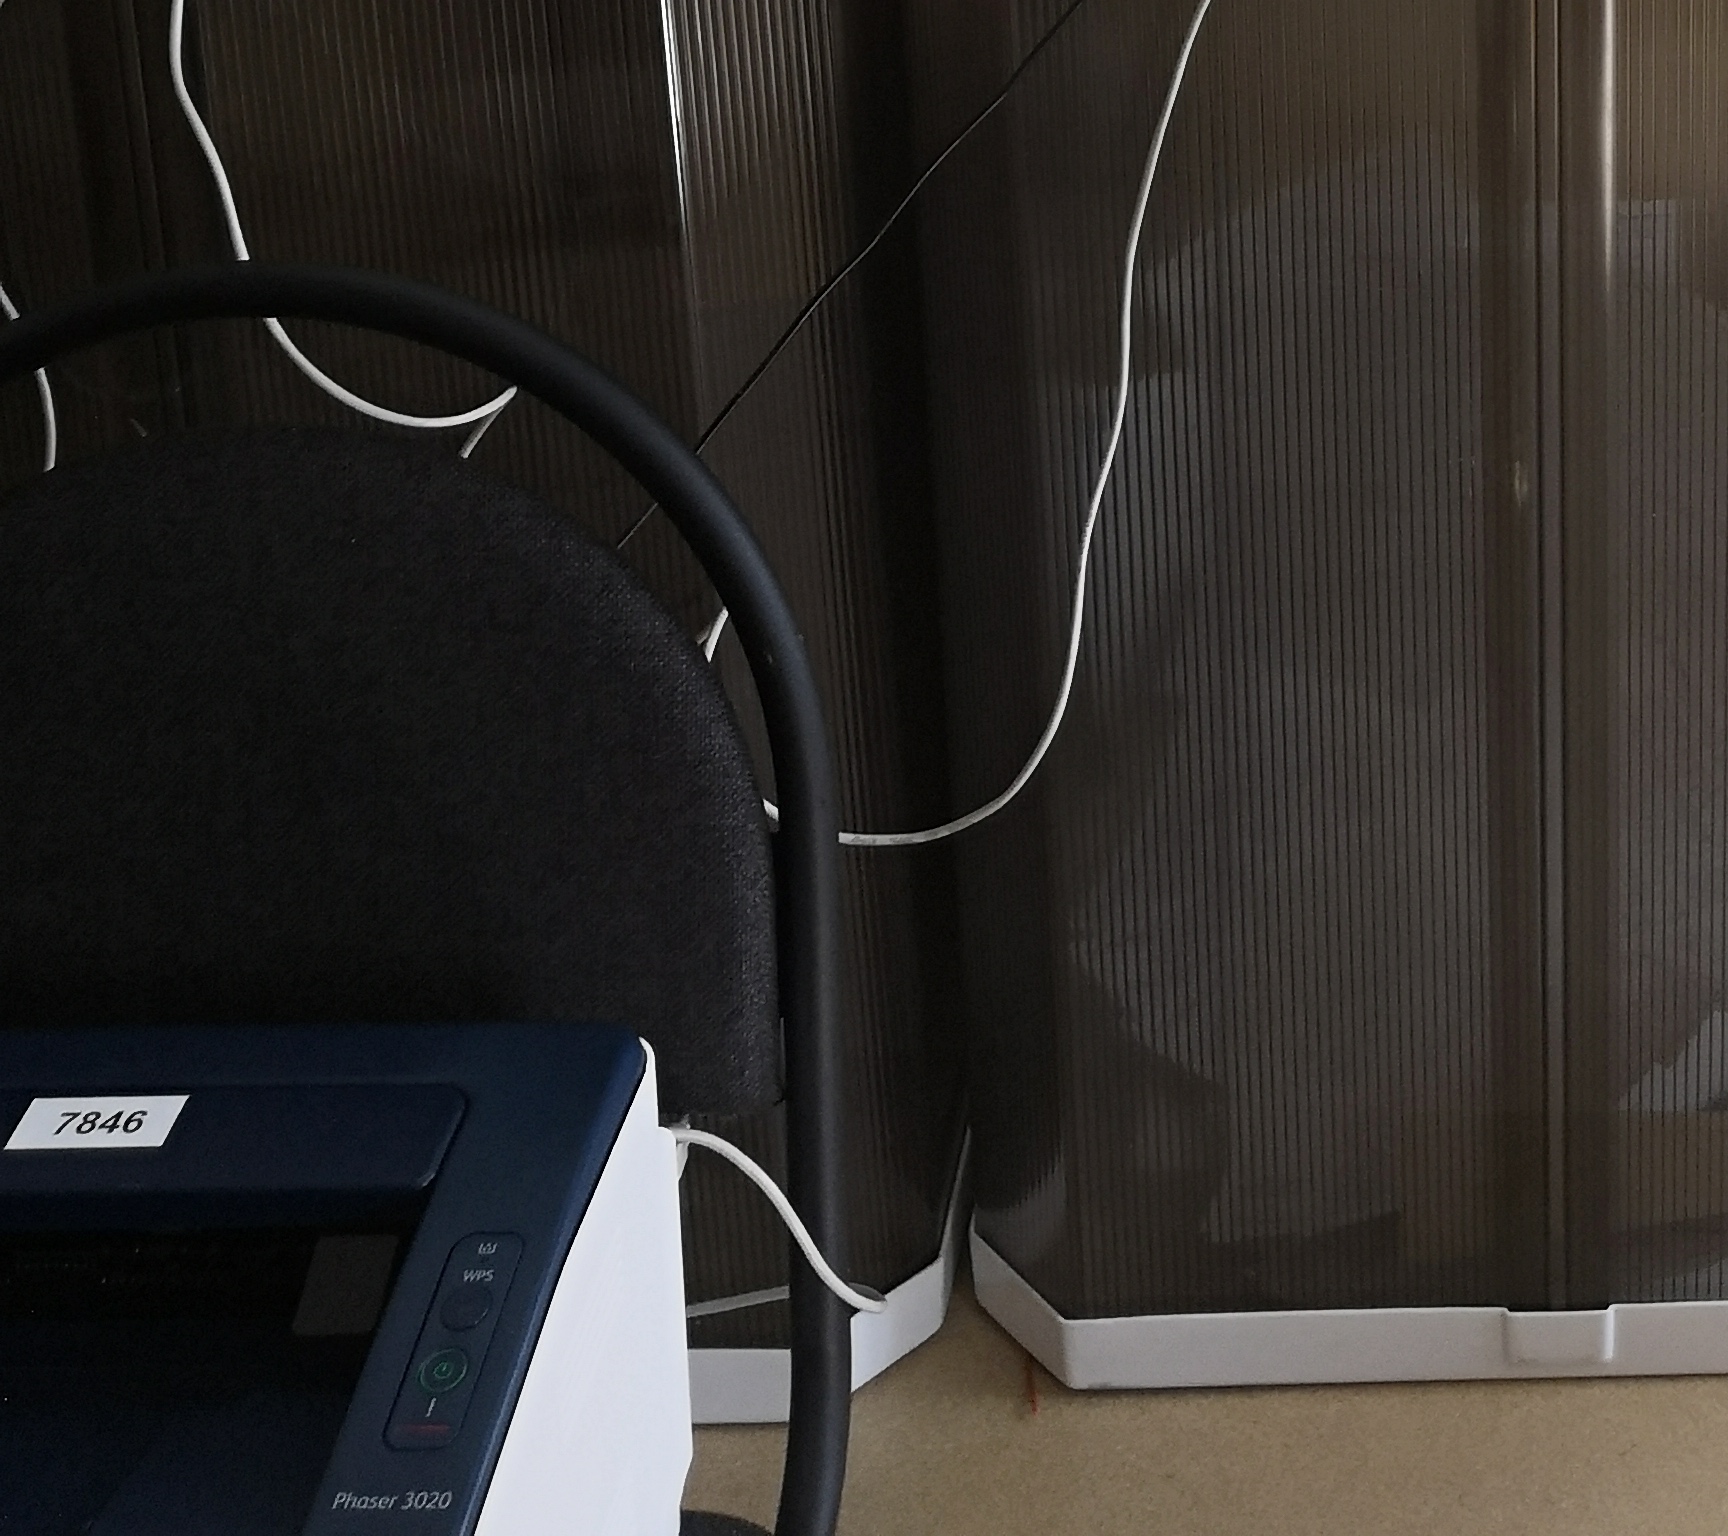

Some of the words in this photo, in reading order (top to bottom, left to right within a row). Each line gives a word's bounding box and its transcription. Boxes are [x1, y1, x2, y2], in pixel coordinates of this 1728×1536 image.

[53, 1110, 148, 1135] 7846
[463, 1269, 495, 1282] WPS
[332, 1491, 399, 1509] Phaser
[401, 1490, 453, 1510] 3020
